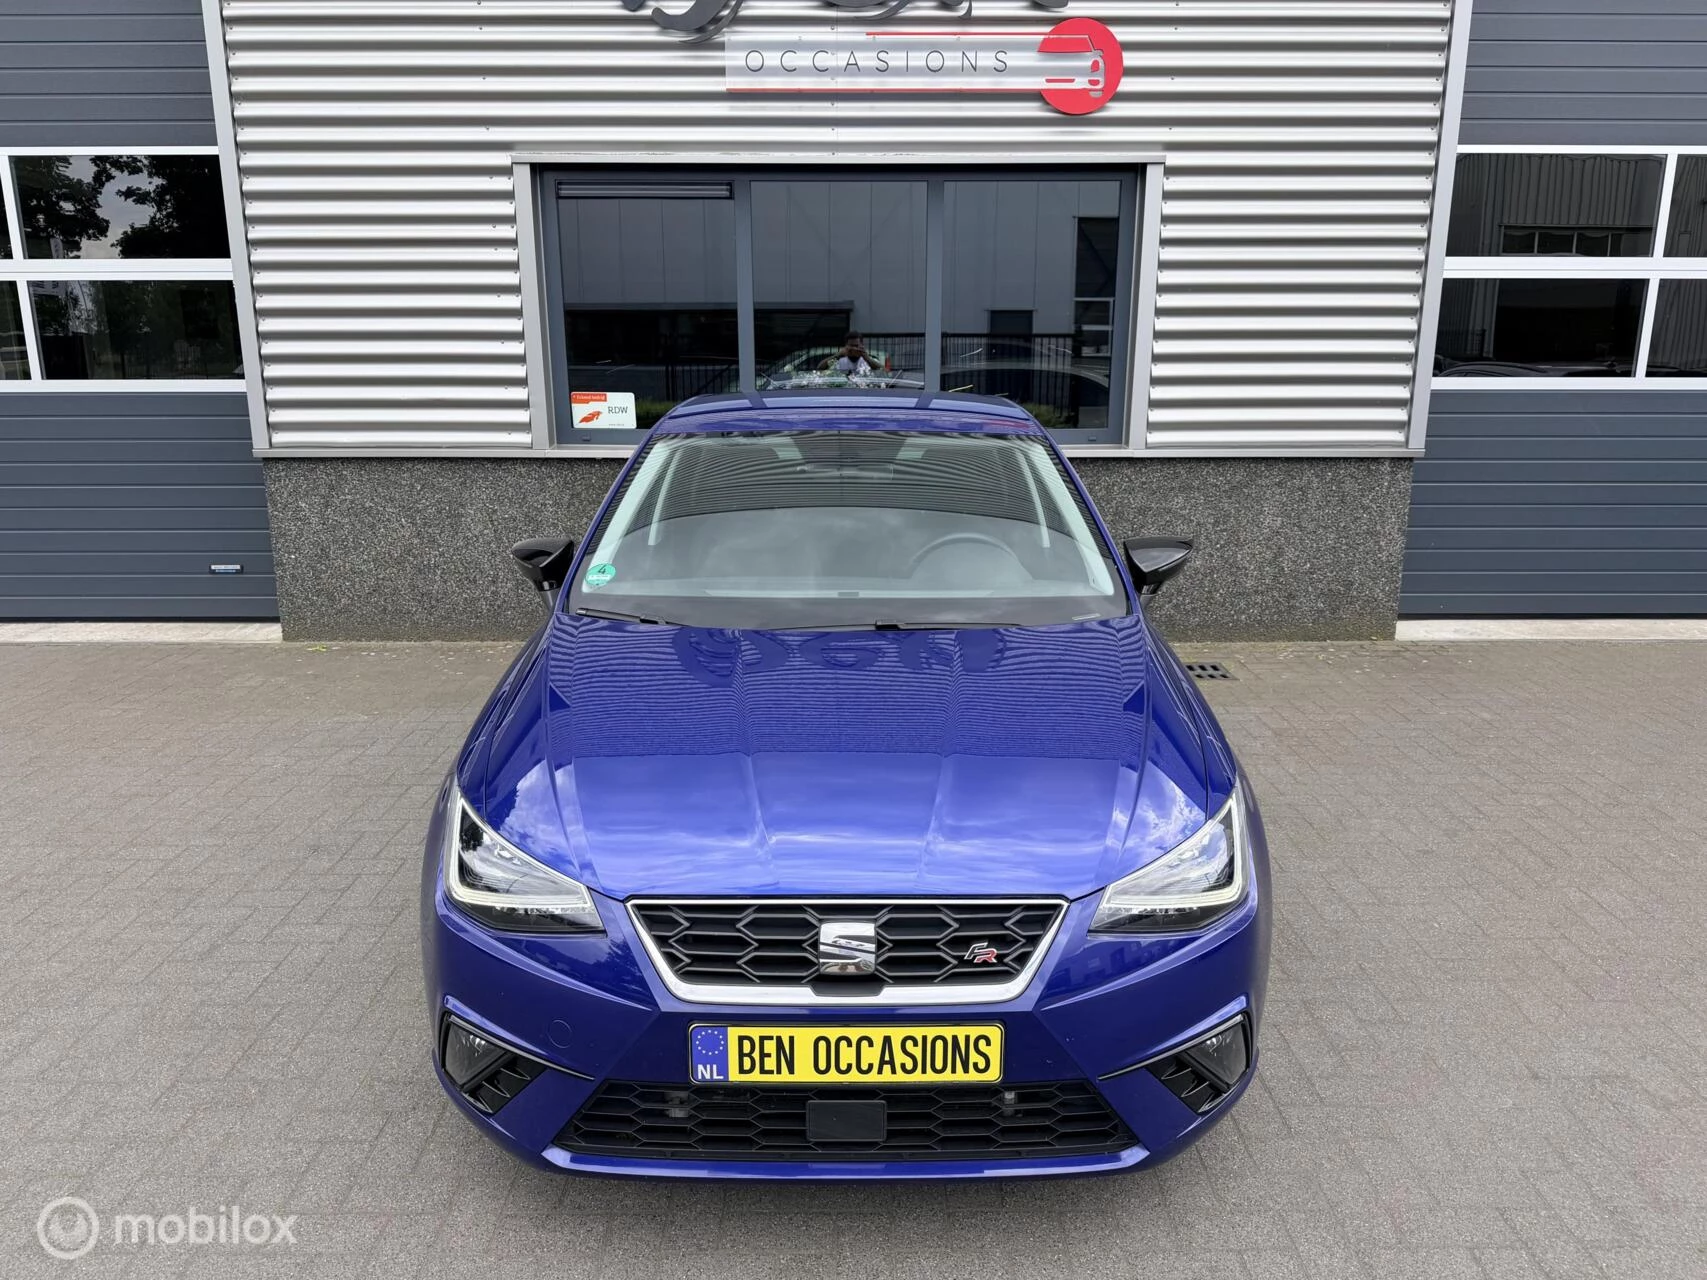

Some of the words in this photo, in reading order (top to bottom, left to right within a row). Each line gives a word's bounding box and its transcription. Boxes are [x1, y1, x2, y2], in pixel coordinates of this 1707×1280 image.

[744, 49, 1009, 73] OCCASIONS
[607, 406, 629, 414] RDW
[598, 564, 606, 574] 4
[963, 942, 998, 963] FR
[697, 1063, 724, 1079] NL
[737, 1034, 796, 1076] BEN
[812, 1033, 992, 1076] OCCASIONS
